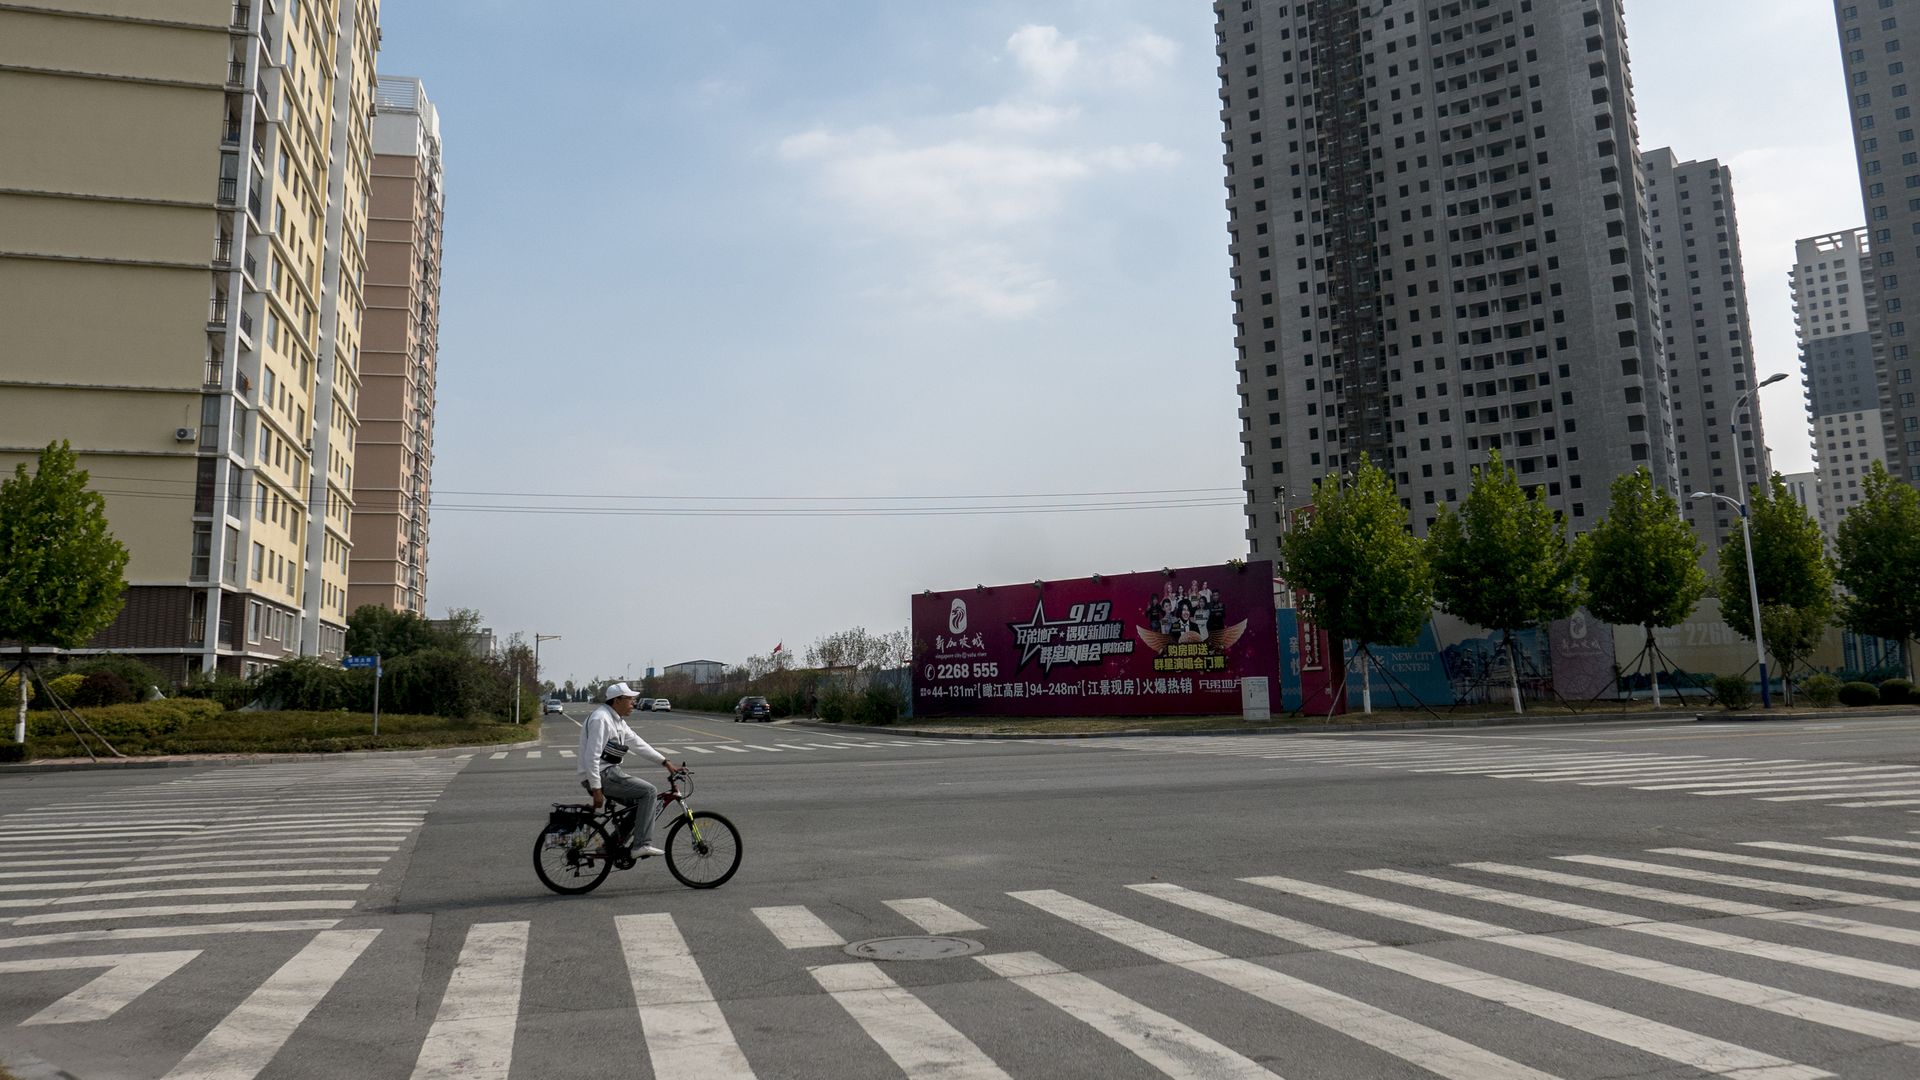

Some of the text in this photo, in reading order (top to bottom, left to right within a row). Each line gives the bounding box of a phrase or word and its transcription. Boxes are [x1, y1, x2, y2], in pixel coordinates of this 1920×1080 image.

[1069, 601, 1111, 623] 9.13
[1167, 643, 1209, 657] 购房即送
[1391, 651, 1435, 661] NEW CITY
[937, 662, 998, 679] 2268 555
[1154, 655, 1225, 671] 群星演唱会门票
[1391, 662, 1430, 672] CENTER
